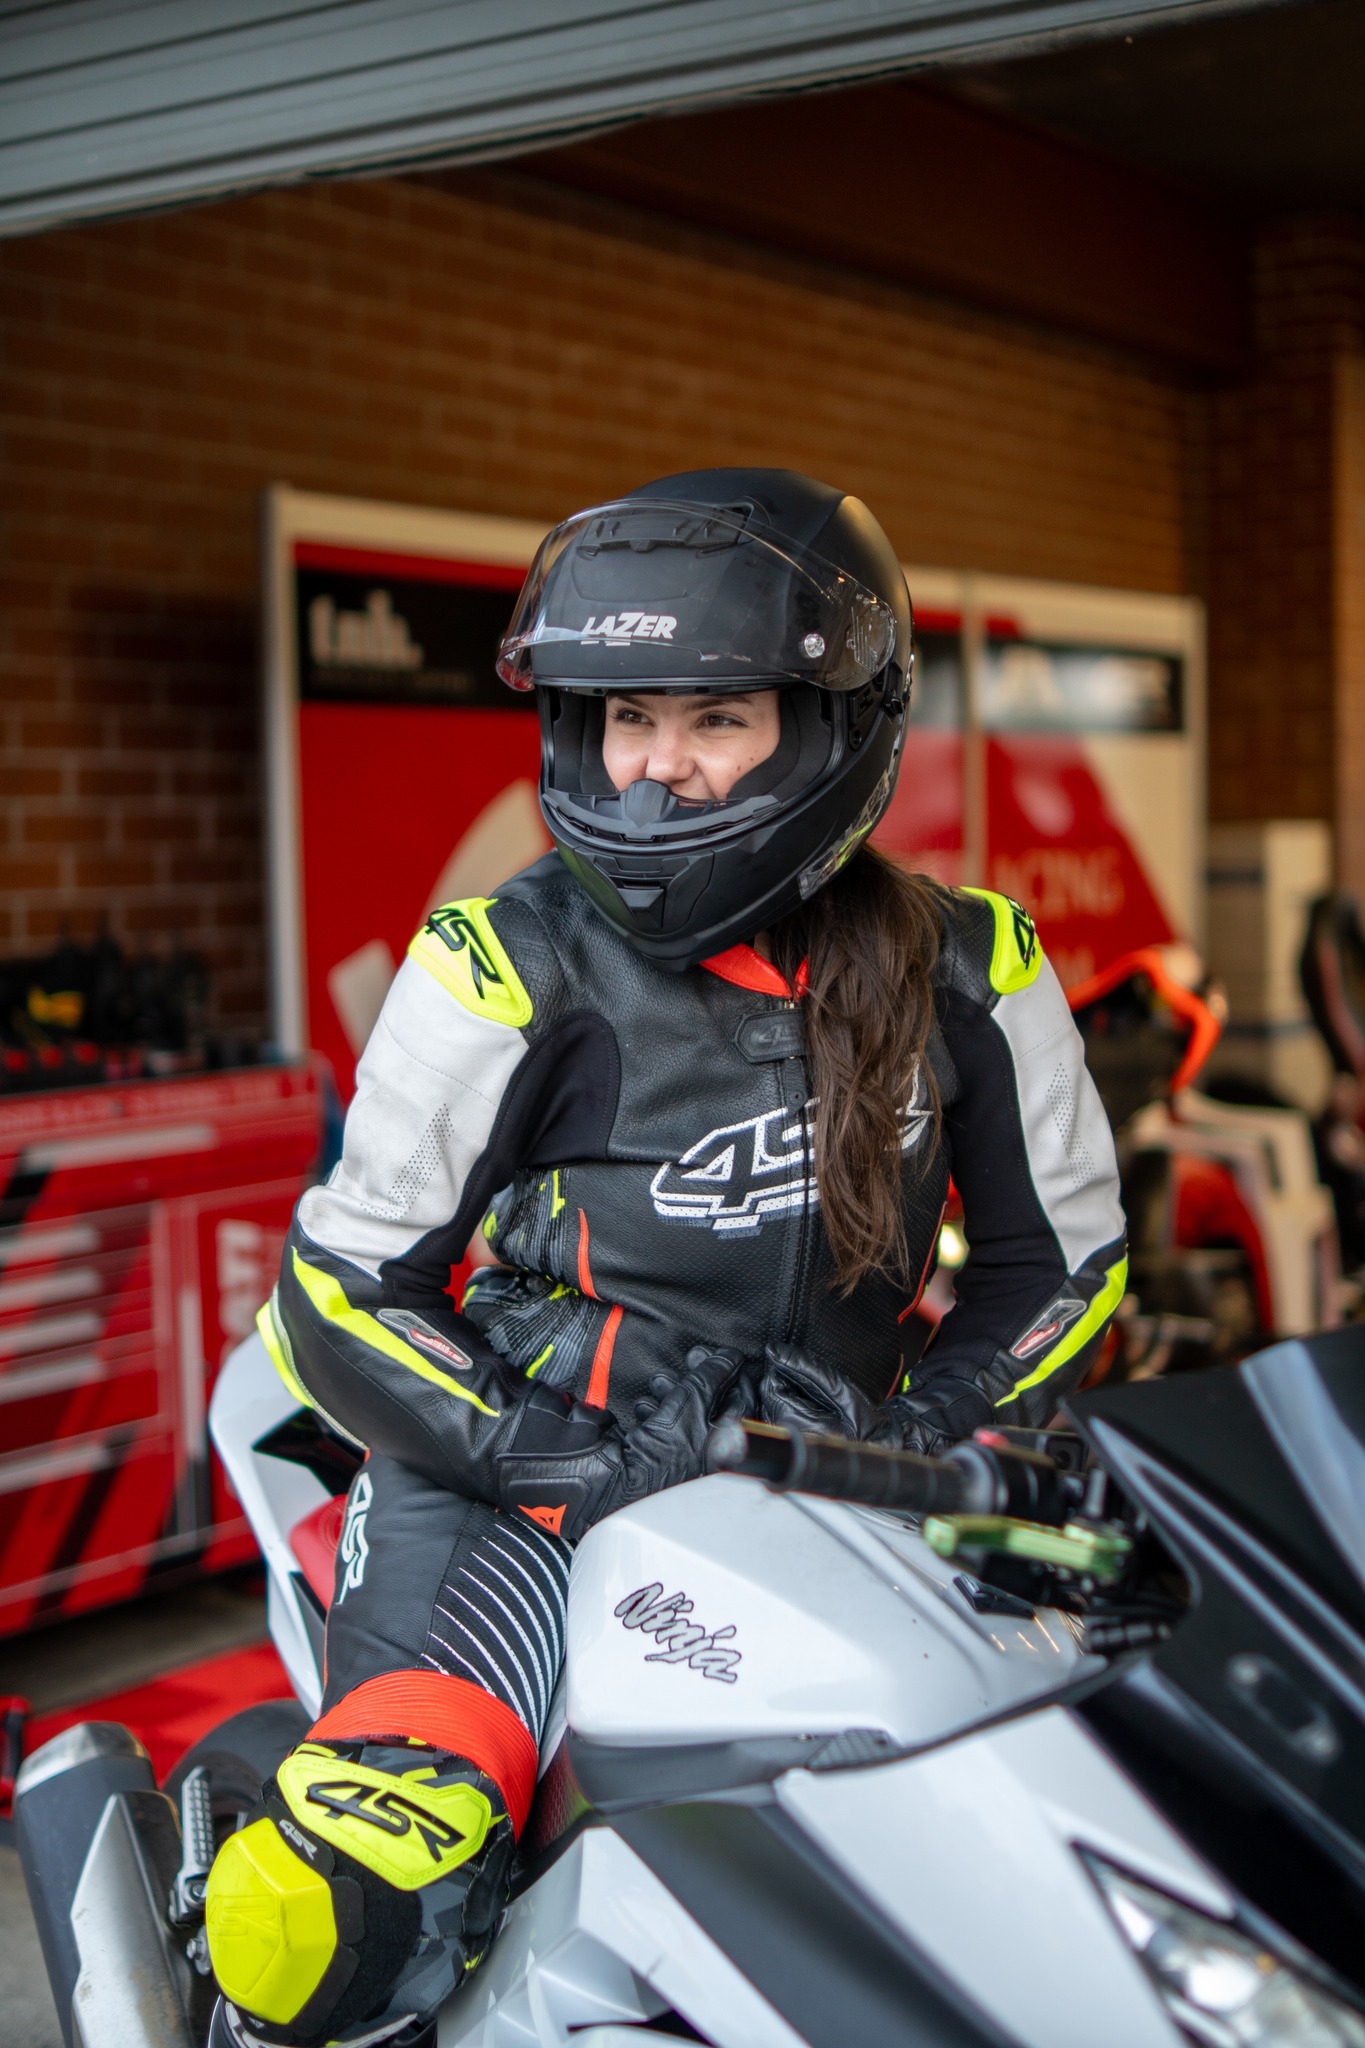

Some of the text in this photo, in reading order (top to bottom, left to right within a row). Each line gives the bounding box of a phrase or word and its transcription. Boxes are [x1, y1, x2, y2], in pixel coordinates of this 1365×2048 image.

[580, 612, 677, 640] LAZER
[424, 907, 505, 1000] 4SR
[613, 1581, 742, 1684] Ninja
[279, 1819, 318, 1861] 4SR
[306, 1780, 467, 1863] 4SR
